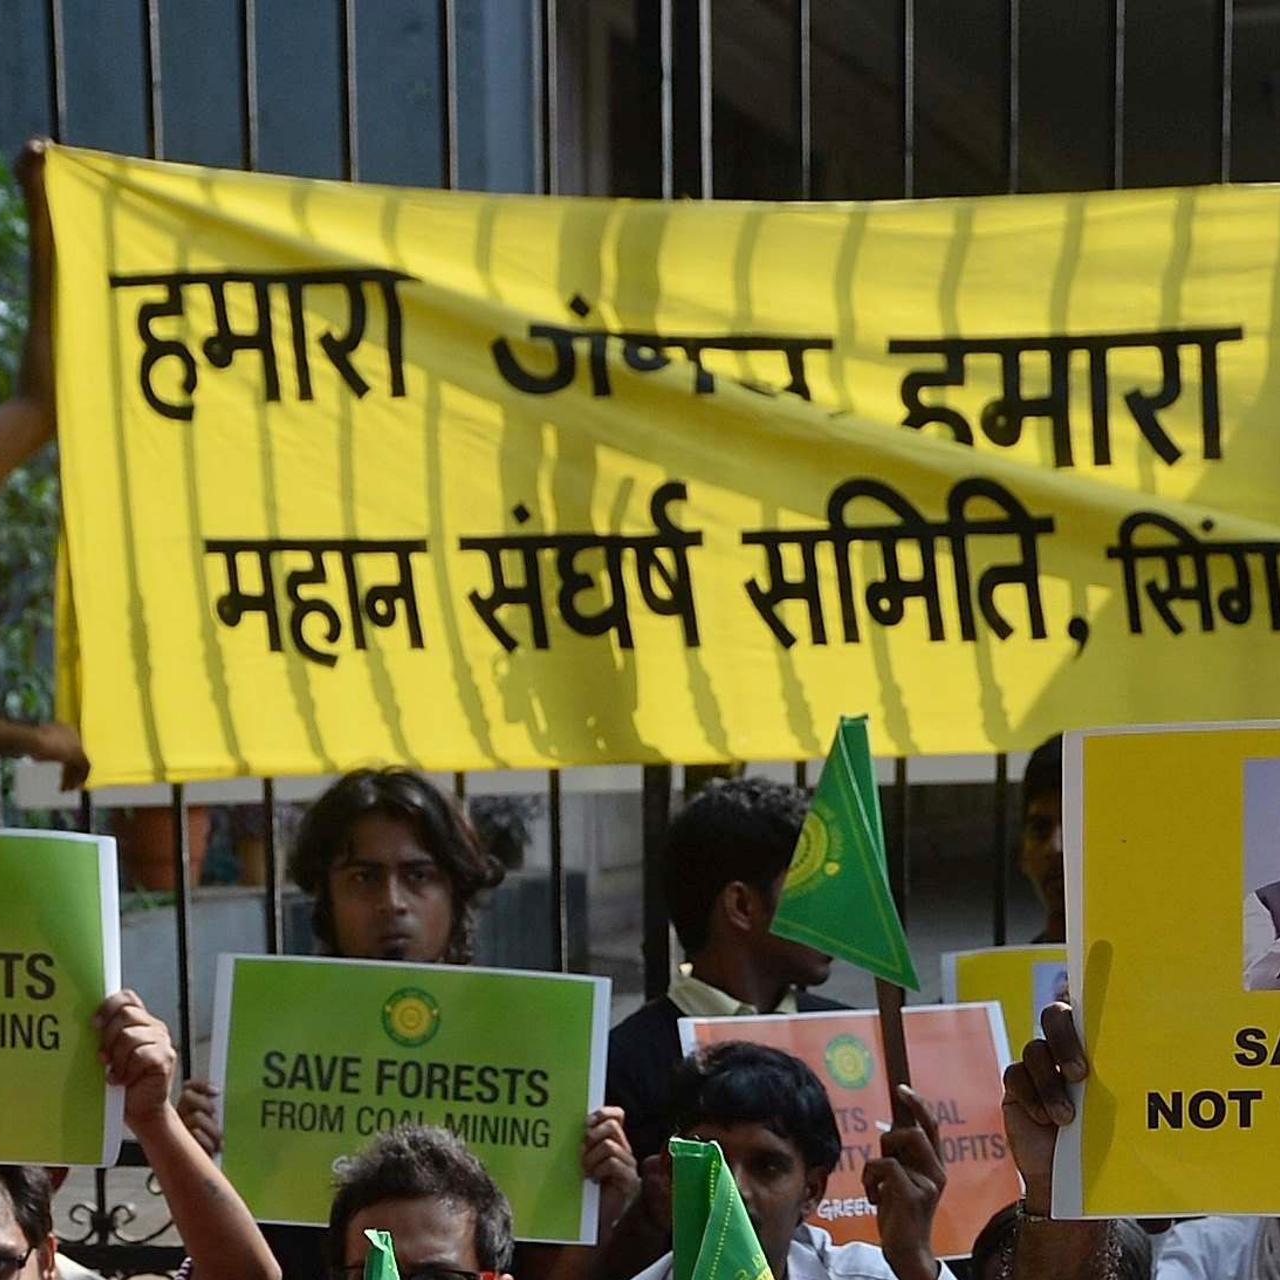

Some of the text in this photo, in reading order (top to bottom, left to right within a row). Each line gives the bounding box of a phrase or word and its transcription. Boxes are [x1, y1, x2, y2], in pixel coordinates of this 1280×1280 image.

[110, 266, 422, 422] हमारा
[889, 326, 1243, 469] हमारा
[205, 538, 427, 668] महान
[459, 481, 702, 653] संघर्ष
[741, 476, 1089, 657] समिति,
[262, 1050, 550, 1107] SAVE FORESTS
[260, 1100, 344, 1133] FROM
[445, 1112, 550, 1148] MINING
[1145, 1090, 1263, 1130] NOT
